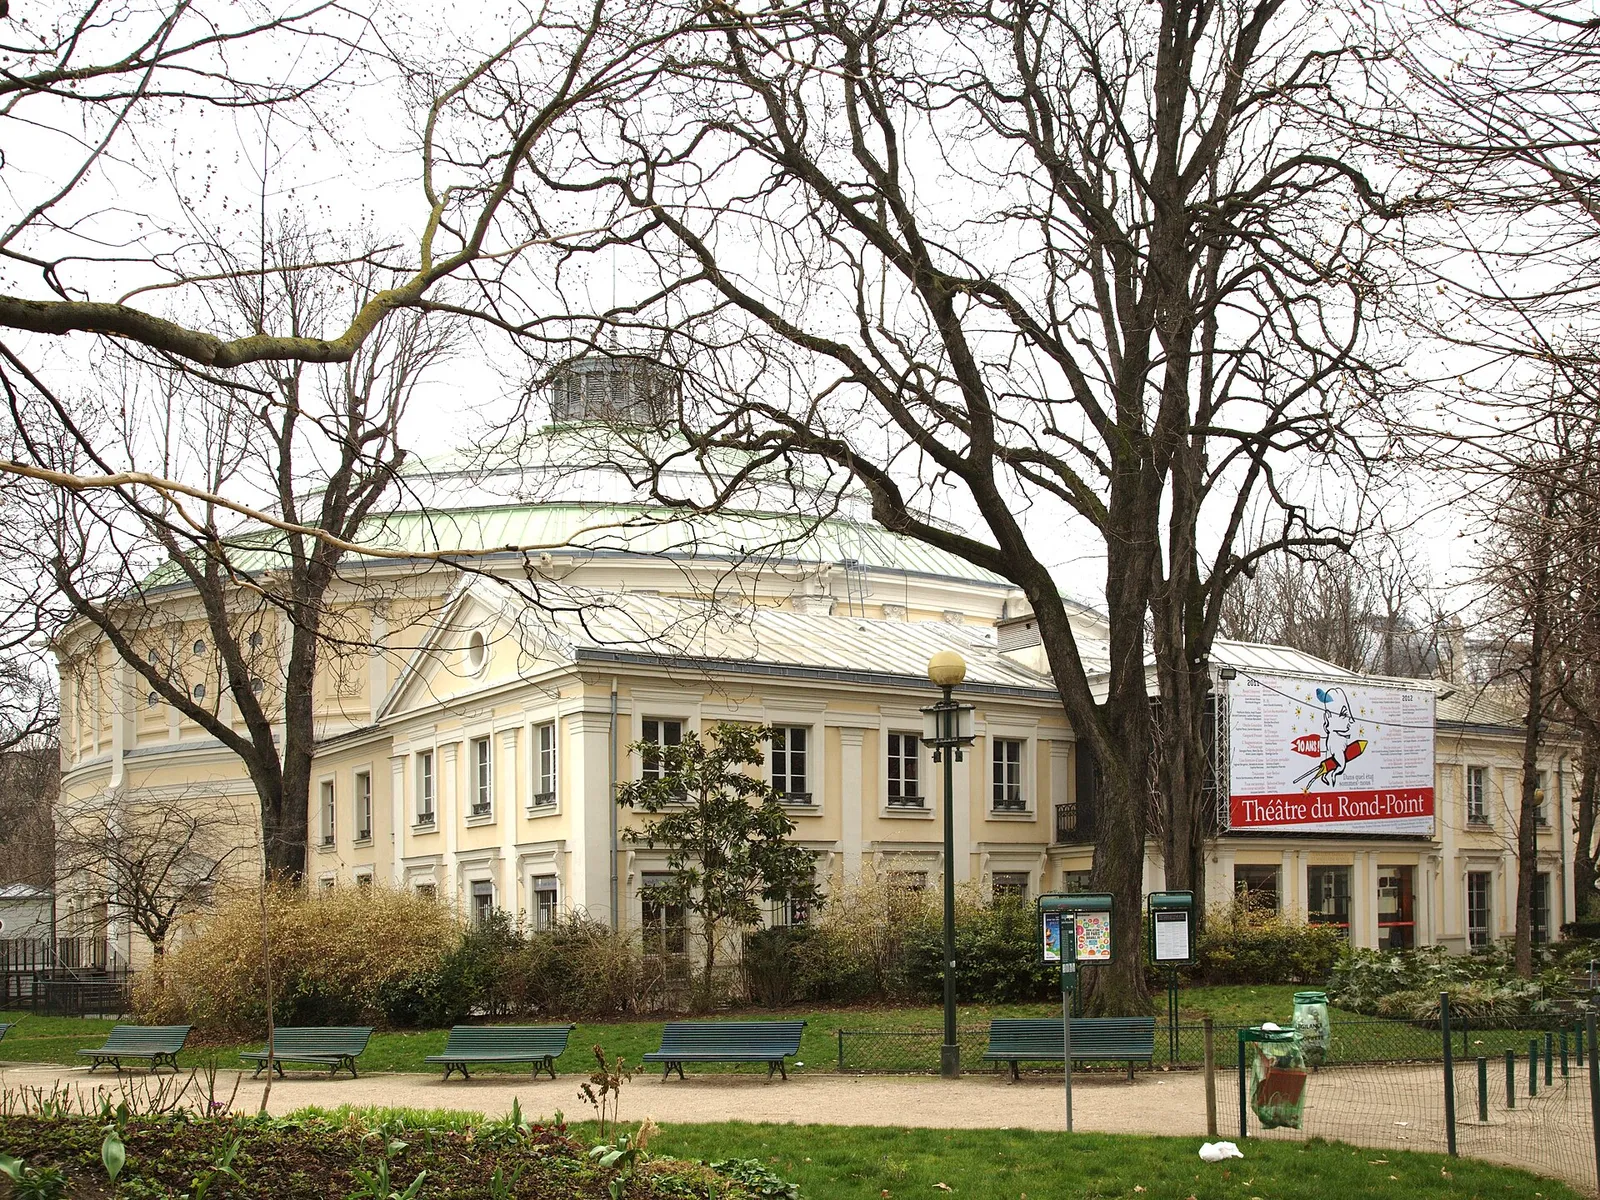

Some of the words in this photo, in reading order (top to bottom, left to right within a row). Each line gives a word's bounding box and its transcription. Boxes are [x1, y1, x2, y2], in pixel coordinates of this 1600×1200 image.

[1296, 740, 1305, 752] 10
[1242, 799, 1307, 822] Théâtre
[1311, 797, 1333, 819] du
[1337, 794, 1424, 817] Rond-Point
